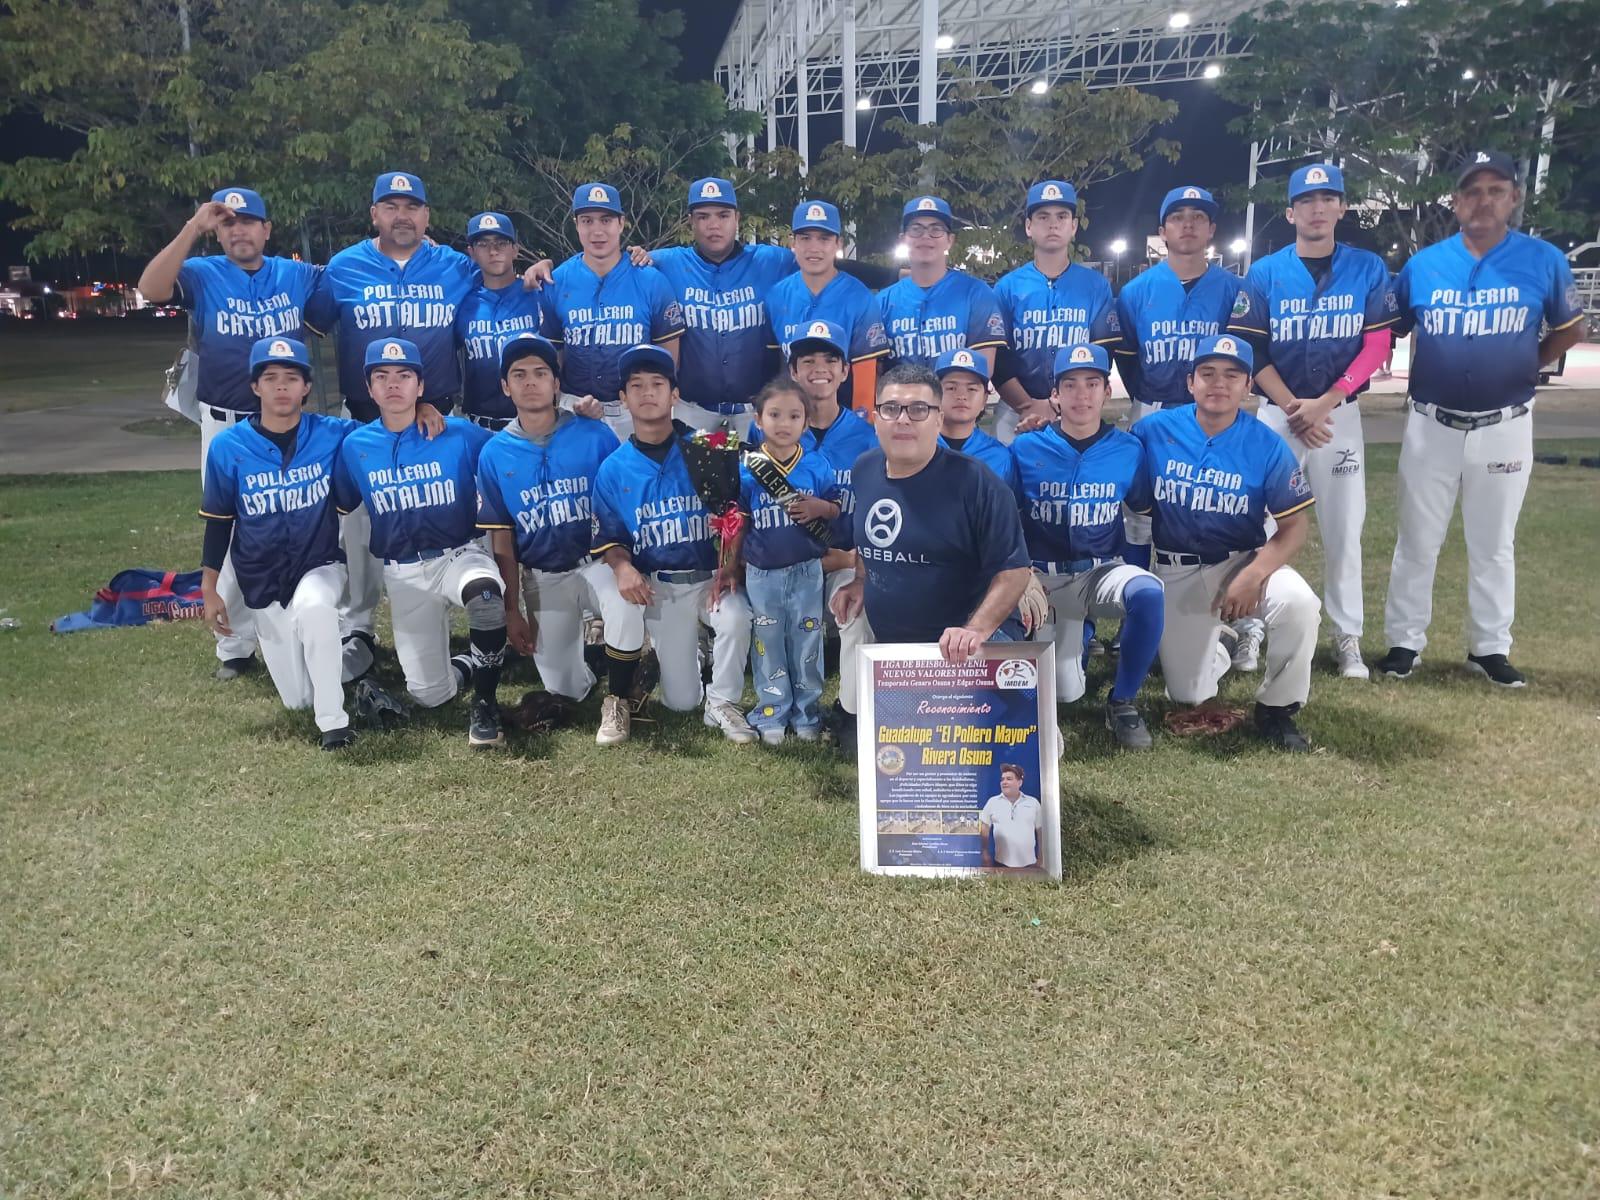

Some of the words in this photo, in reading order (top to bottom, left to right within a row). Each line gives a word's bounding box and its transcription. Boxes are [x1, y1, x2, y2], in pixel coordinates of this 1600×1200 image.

[364, 284, 444, 300] POLLERIA
[684, 286, 755, 306] POLLERIA
[1431, 286, 1519, 308] POLLERIA
[568, 305, 634, 324] POLLERIA
[1280, 294, 1354, 315] POLLERIA
[217, 305, 301, 337] CATALINA
[353, 302, 456, 331] CATALINA
[468, 314, 533, 336] POLLERIA
[682, 301, 767, 332] ATALINA
[891, 315, 957, 334] POLLERIA
[1023, 307, 1087, 325] POLLERIA
[1424, 306, 1529, 337] CATALINA
[563, 323, 644, 346] CATALINA
[1013, 326, 1091, 351] CATALINA
[1151, 320, 1219, 337] POLLERIA
[1270, 313, 1364, 343] CATALINA
[245, 462, 323, 489] POLLERIA
[369, 461, 442, 488] POLLERIA
[1166, 459, 1243, 491] POLLERIA
[1332, 464, 1360, 474] IMDEM
[241, 474, 332, 517] CATALINA
[520, 475, 589, 506] POLLERIA
[1039, 481, 1117, 500] POLLERIA
[1154, 474, 1249, 515] CATALINA
[516, 494, 593, 535] CATALIN
[635, 493, 703, 521] POLLERIA
[1030, 500, 1121, 528] CATALINA
[856, 546, 931, 564] ASEBALL
[881, 660, 900, 668] LIGA
[903, 660, 913, 668] DE
[915, 660, 950, 668] BEISBOL
[952, 660, 988, 668] UVENIL
[883, 669, 916, 678] NUEVOS
[918, 669, 956, 678] VALORES
[958, 669, 988, 678] IMDEM
[957, 679, 975, 687] Edgar
[917, 700, 992, 714] Reconocimiento
[879, 726, 932, 745] Guadalupe
[953, 726, 992, 743] Pollero
[921, 748, 956, 765] Rivera
[959, 748, 992, 765] Osuna
